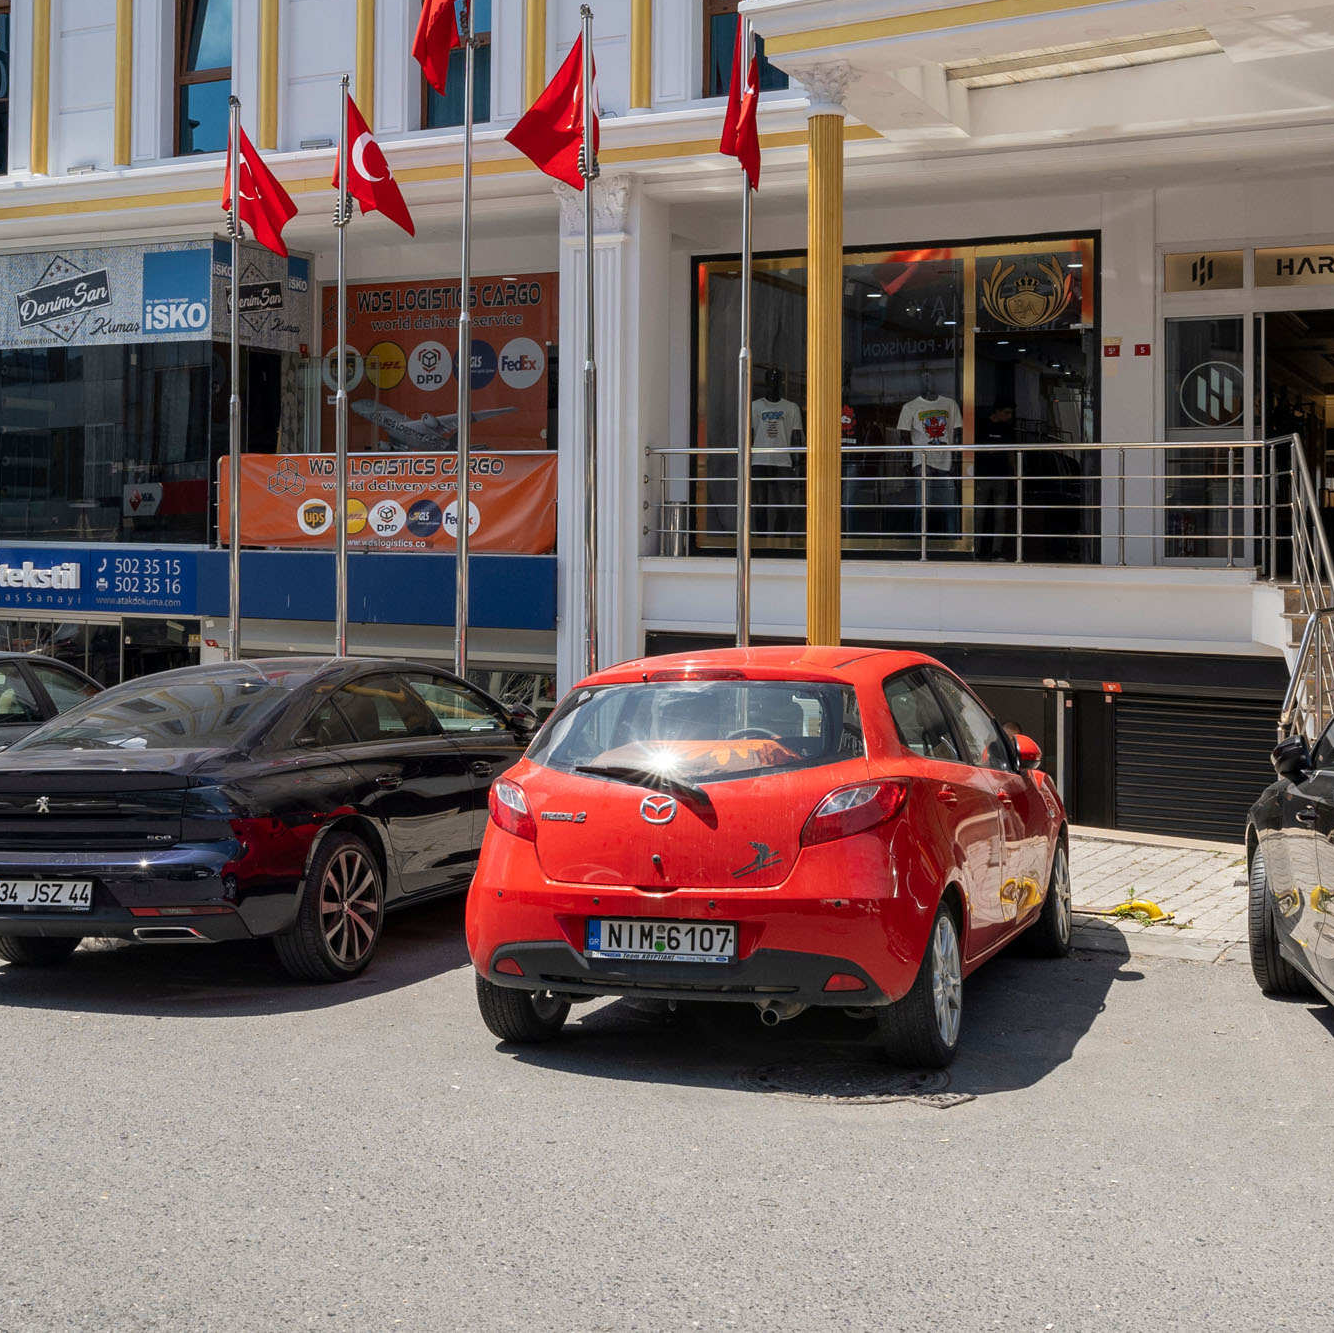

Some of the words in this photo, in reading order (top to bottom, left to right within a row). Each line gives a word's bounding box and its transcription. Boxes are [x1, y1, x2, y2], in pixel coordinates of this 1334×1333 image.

[20, 282, 108, 322] DenimSan
[357, 290, 392, 313] WDS
[482, 282, 541, 308] CARGO
[371, 316, 411, 331] world
[414, 315, 463, 329] deliver
[474, 313, 523, 327] service
[501, 355, 537, 371] FedEx
[417, 374, 443, 385] DPD
[309, 458, 338, 475] WD
[351, 457, 436, 475] LOGISTICS
[441, 457, 505, 475] CRGO
[368, 479, 427, 493] delivery
[429, 480, 483, 491] servce
[305, 511, 325, 526] ups
[376, 524, 398, 532] DPD
[346, 539, 426, 549] ww.wdslogistics.co
[115, 558, 139, 574] 502
[144, 558, 160, 574] 35
[165, 559, 180, 575] 15
[115, 577, 139, 593] 502
[144, 577, 160, 594] 35
[165, 578, 180, 594] 16
[26, 592, 81, 605] Sanayi
[95, 596, 181, 608] www.atakdokuma.com
[0, 882, 18, 903] 34
[27, 883, 63, 904] JSZ
[69, 883, 89, 904] 44
